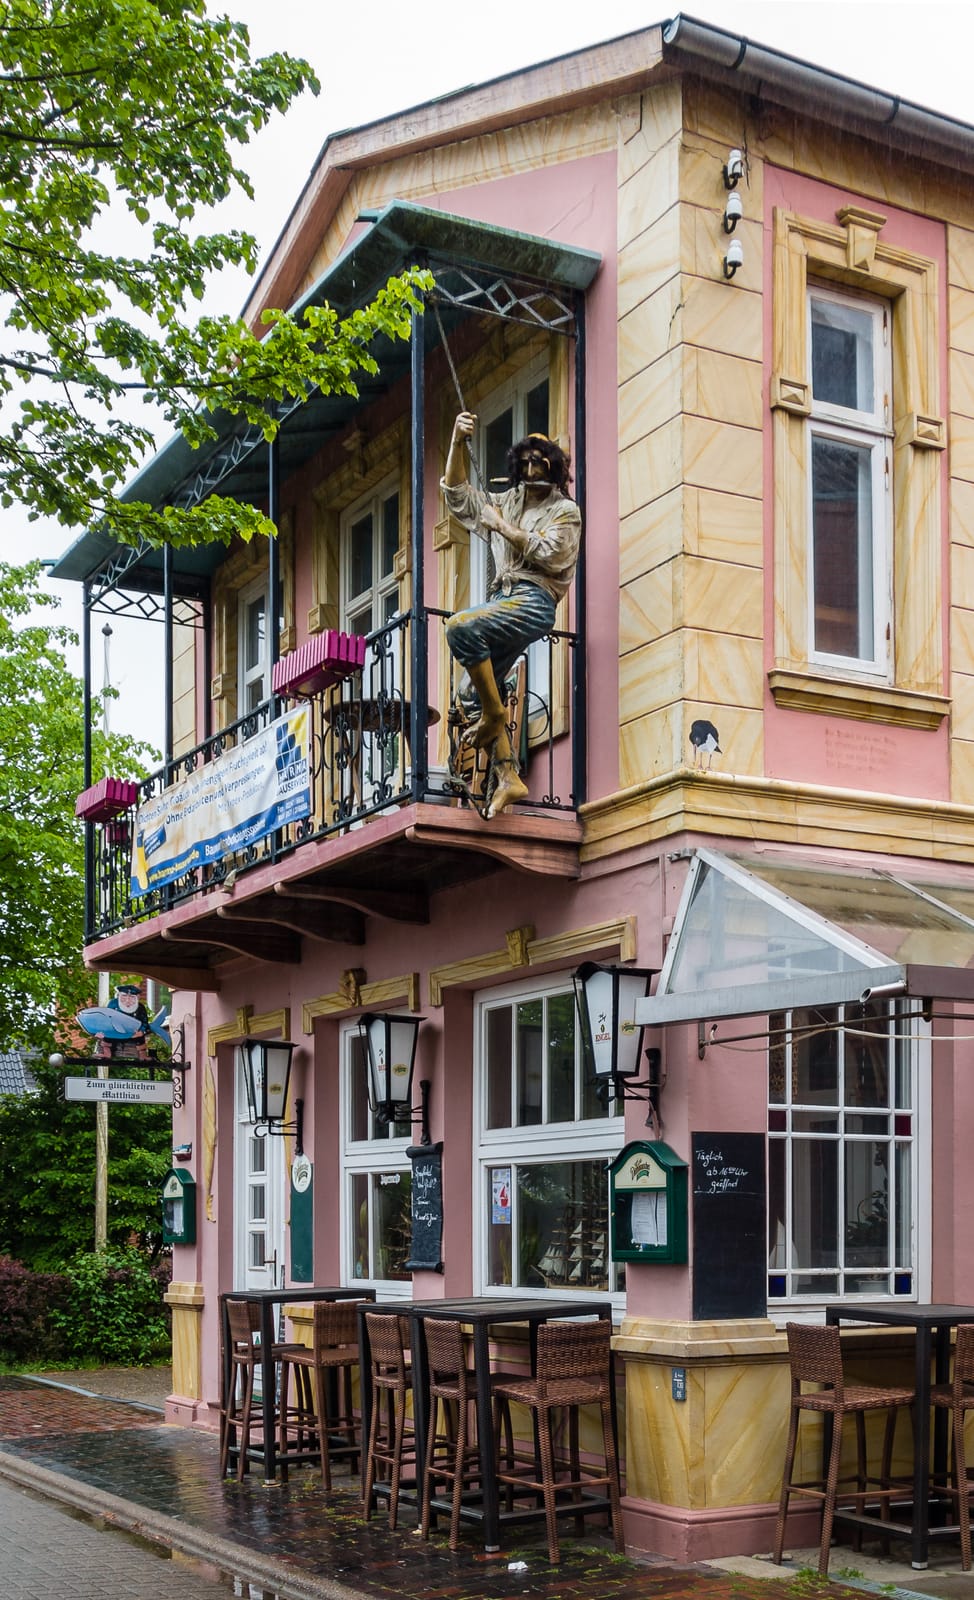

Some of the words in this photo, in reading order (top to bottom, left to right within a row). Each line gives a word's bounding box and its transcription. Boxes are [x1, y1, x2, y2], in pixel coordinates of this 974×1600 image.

[86, 1080, 106, 1089] Zum
[108, 1081, 156, 1091] glücklichen
[102, 1090, 140, 1100] Matthias
[695, 1149, 724, 1168] Täglich
[706, 1165, 718, 1176] ab
[709, 1178, 739, 1194] geöffnet
